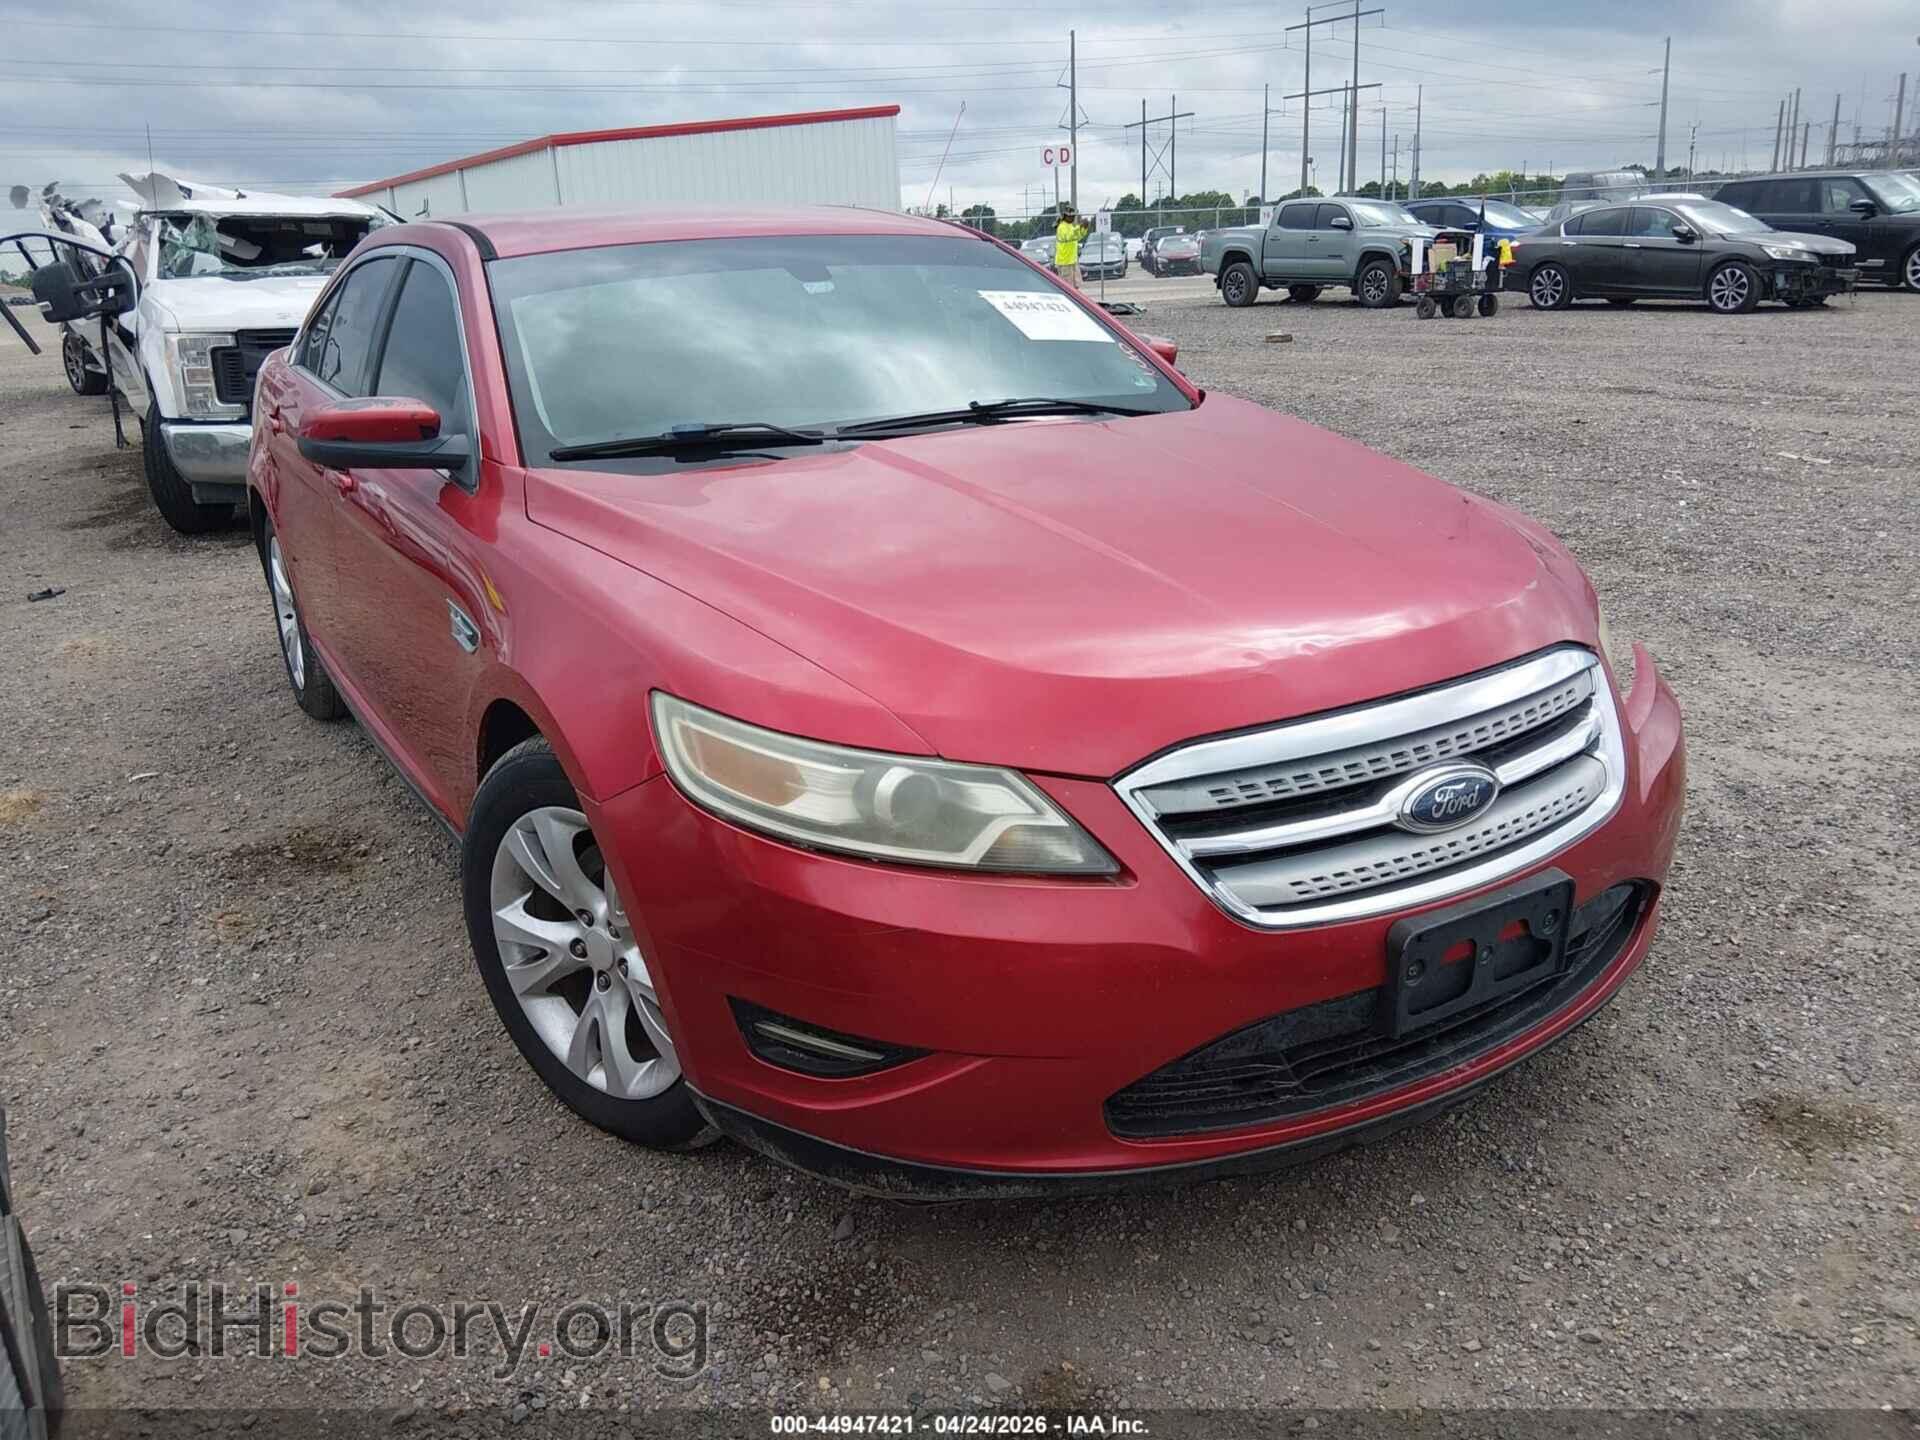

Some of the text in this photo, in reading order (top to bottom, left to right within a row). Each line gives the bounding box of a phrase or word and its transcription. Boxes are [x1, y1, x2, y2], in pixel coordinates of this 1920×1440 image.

[1043, 147, 1070, 165] C D
[1431, 781, 1480, 818] Ford
